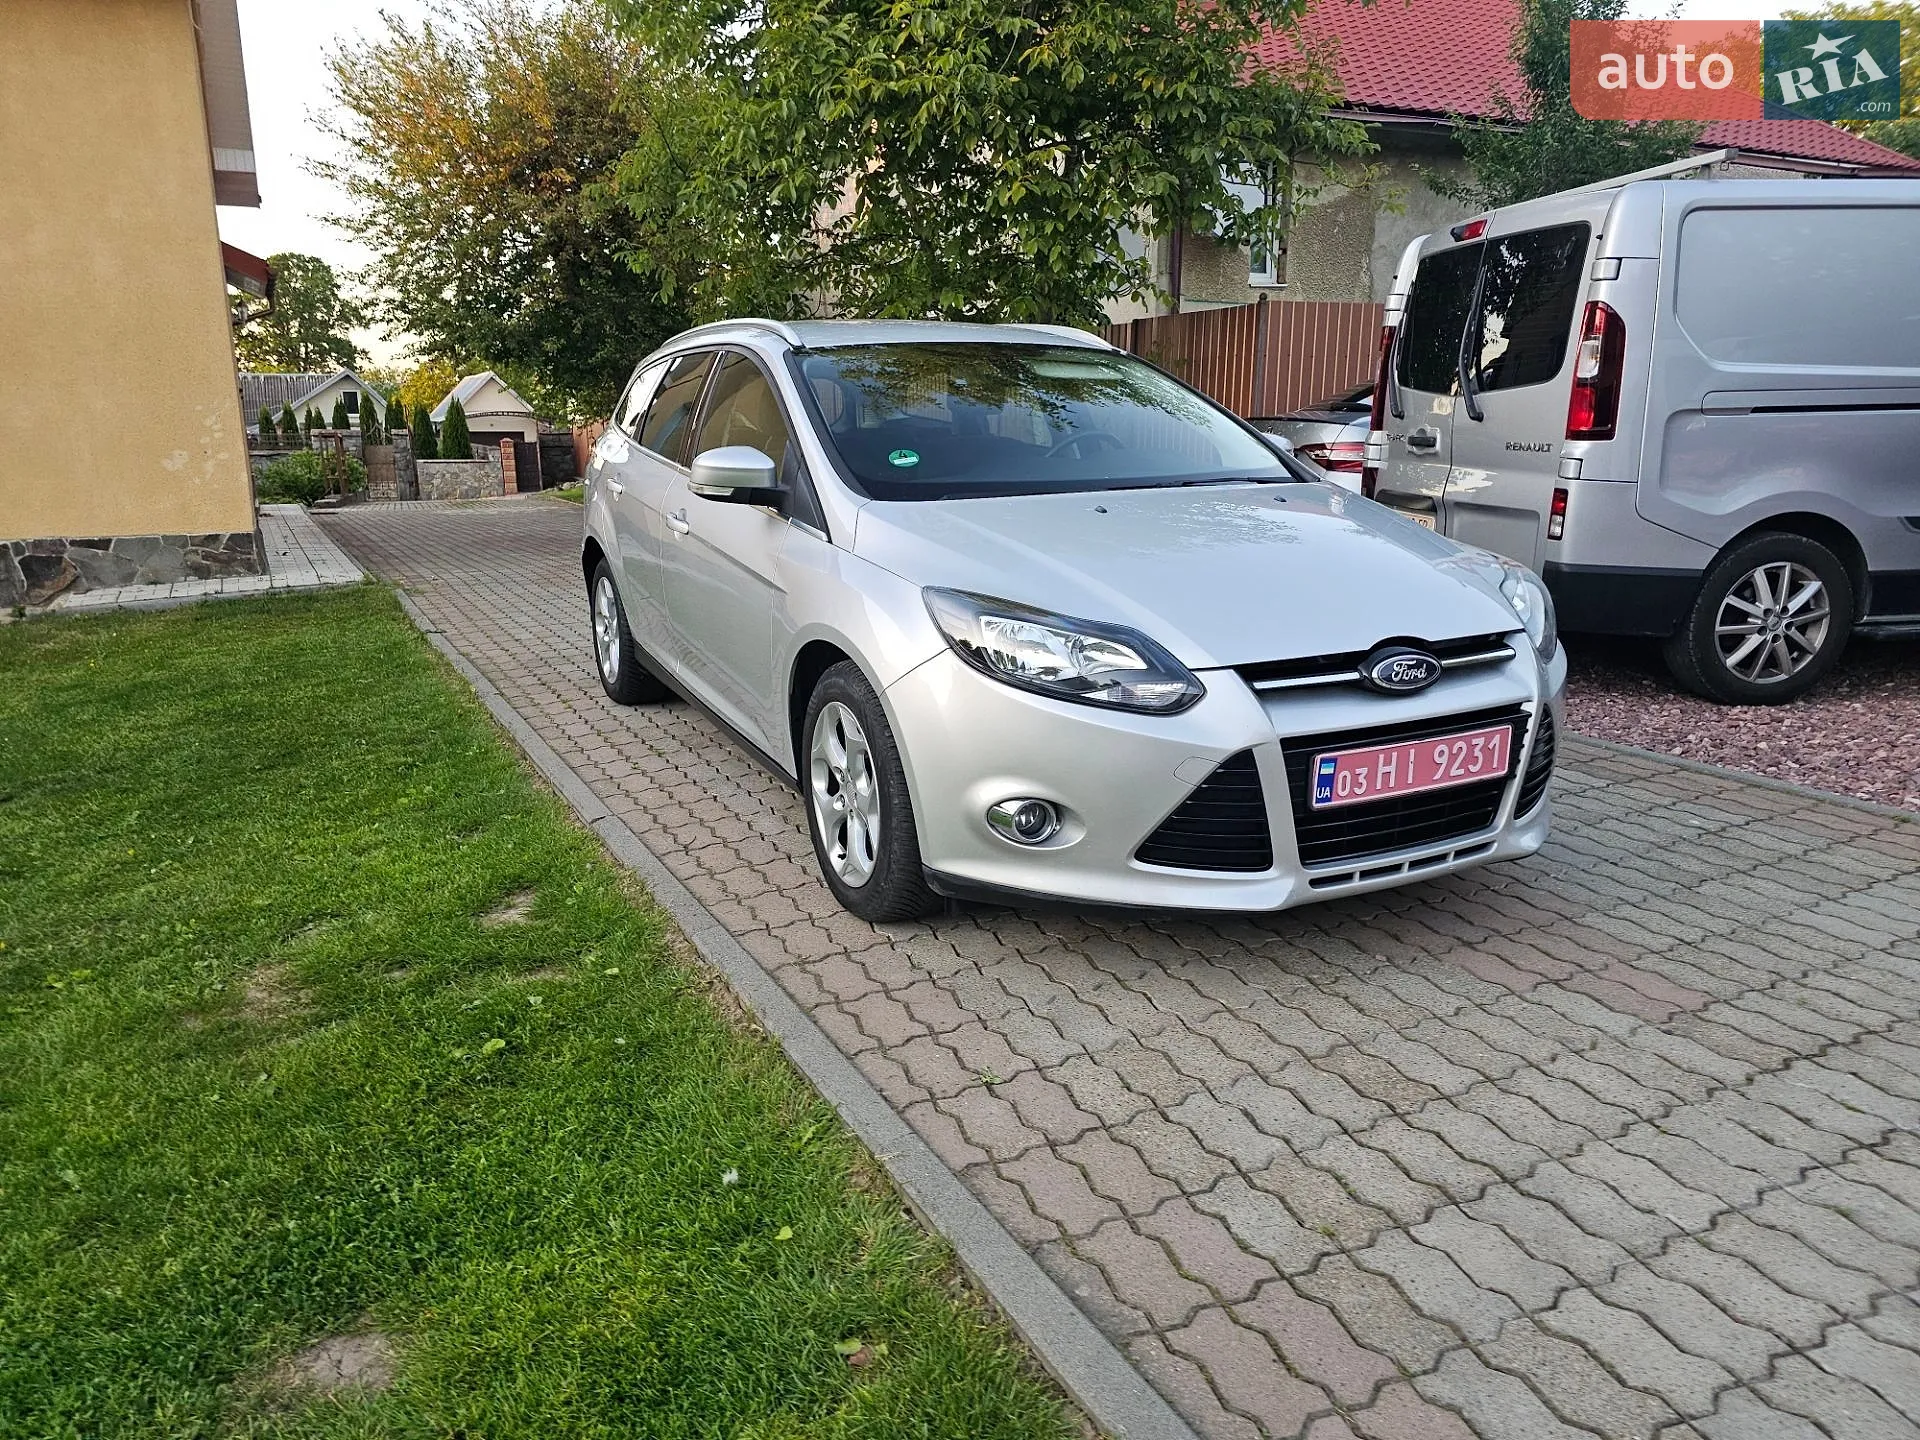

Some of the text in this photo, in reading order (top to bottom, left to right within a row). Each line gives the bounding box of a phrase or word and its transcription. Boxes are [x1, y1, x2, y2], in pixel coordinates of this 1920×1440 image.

[1504, 441, 1553, 453] RENAULT
[1391, 659, 1428, 683] Ford
[1336, 767, 1369, 798] 03
[1432, 734, 1501, 781] 9231
[1317, 787, 1331, 799] UA
